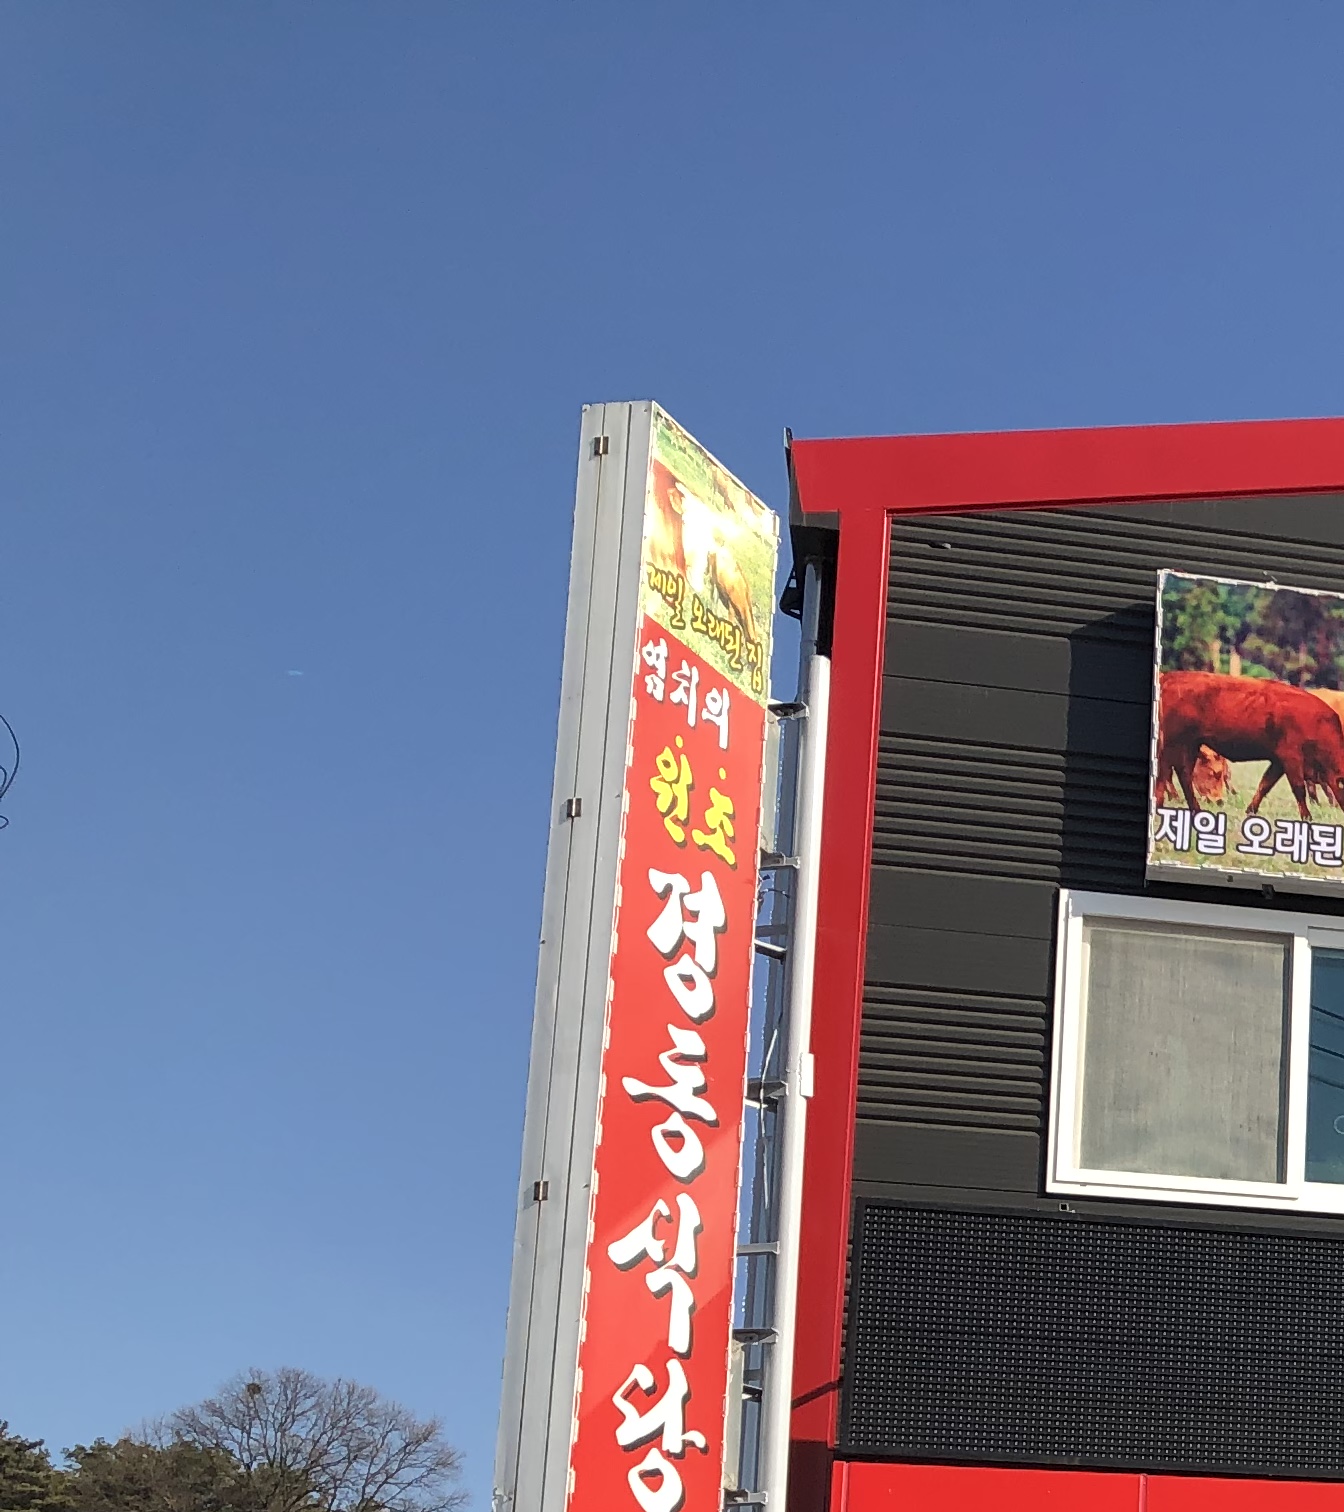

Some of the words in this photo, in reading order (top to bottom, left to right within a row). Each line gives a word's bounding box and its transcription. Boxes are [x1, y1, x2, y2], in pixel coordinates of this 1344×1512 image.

[647, 563, 685, 629] 제일
[691, 595, 744, 673] 오래된
[746, 640, 765, 693] 집
[642, 637, 731, 752] 염치의
[650, 735, 737, 869] 원조
[1154, 806, 1227, 858] 제일
